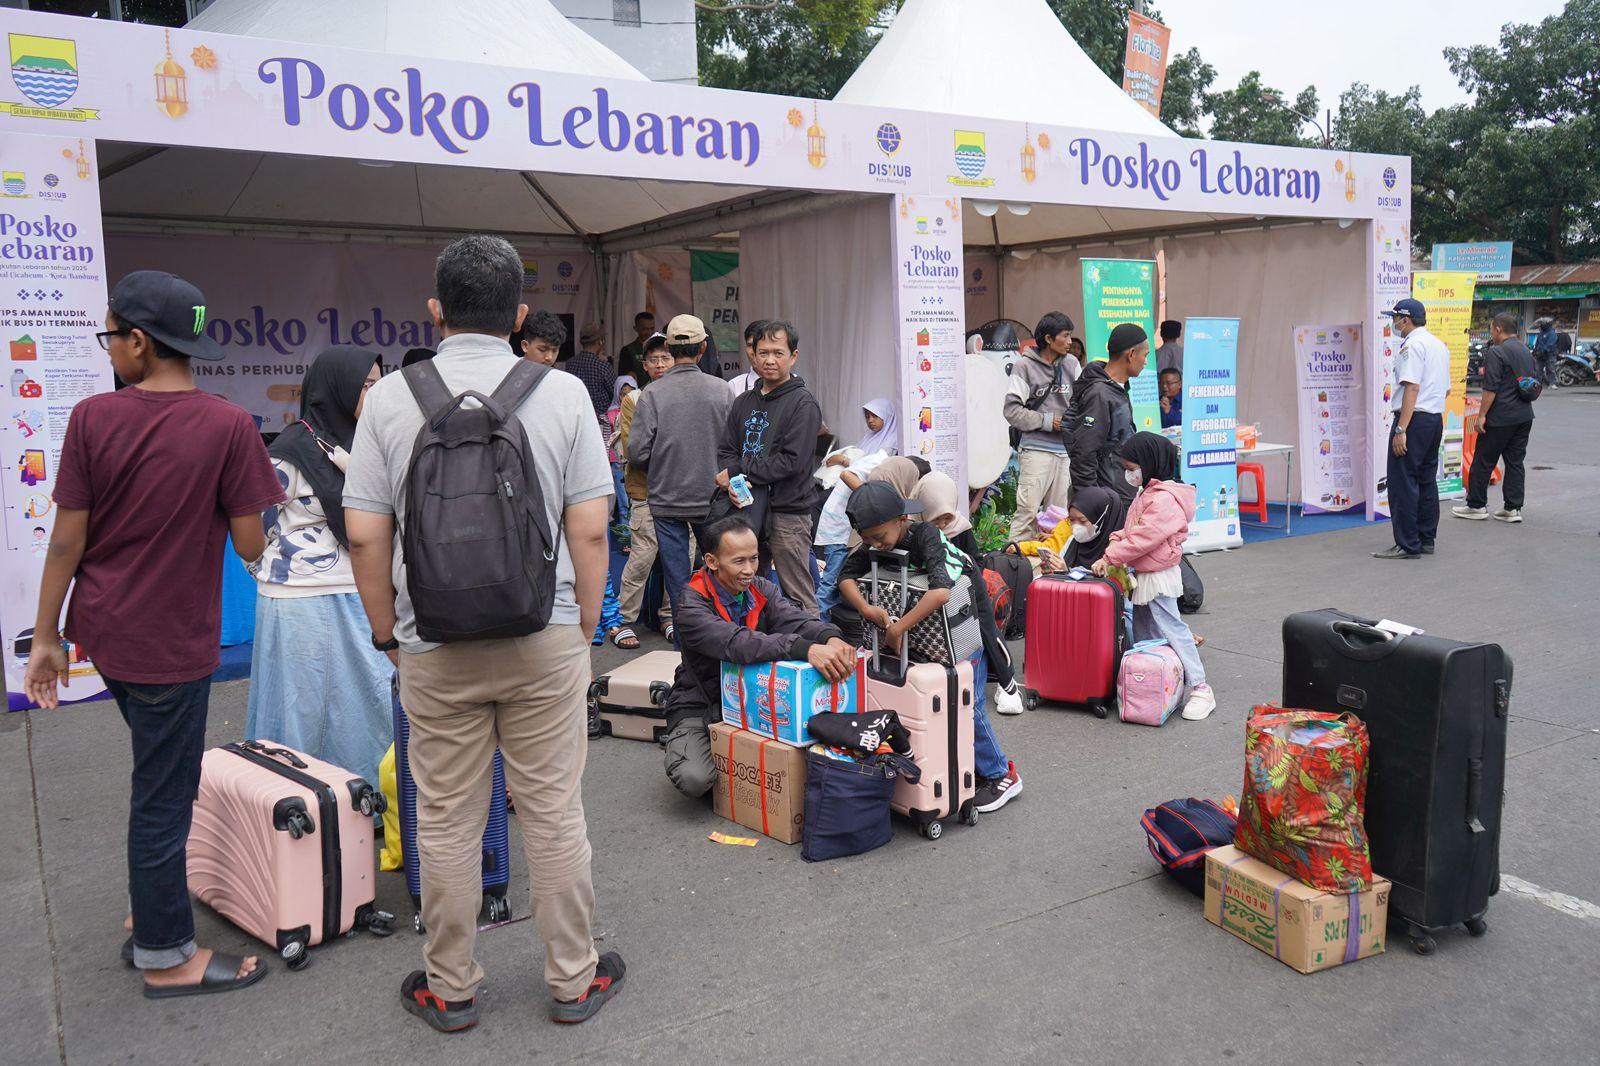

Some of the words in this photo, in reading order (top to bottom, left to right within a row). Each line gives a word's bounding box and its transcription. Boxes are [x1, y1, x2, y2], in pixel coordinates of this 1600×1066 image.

[258, 57, 489, 154] Posko
[508, 82, 760, 167] Lebaran
[868, 163, 912, 178] DISHUB
[1069, 138, 1181, 200] Posko
[1190, 149, 1320, 203] Lebaran
[0, 214, 77, 242] Posko
[0, 237, 94, 263] ebaran
[911, 245, 951, 264] Posko
[904, 261, 959, 278] Lebaran
[1381, 261, 1404, 274] Posko
[1377, 273, 1408, 285] Lebaran
[1438, 289, 1454, 297] TIPS
[206, 306, 306, 354] osko
[318, 307, 437, 347] Lebar
[1312, 350, 1346, 363] Posko
[1199, 369, 1230, 379] PELAYANAN
[1307, 362, 1352, 373] Lebaran
[1206, 404, 1218, 414] DAN
[1201, 432, 1228, 444] GRATIS
[1206, 452, 1235, 464] RAHARJA
[1226, 885, 1266, 911] MEDIUM
[1224, 900, 1276, 940] Resto
[1325, 920, 1340, 942] PCS
